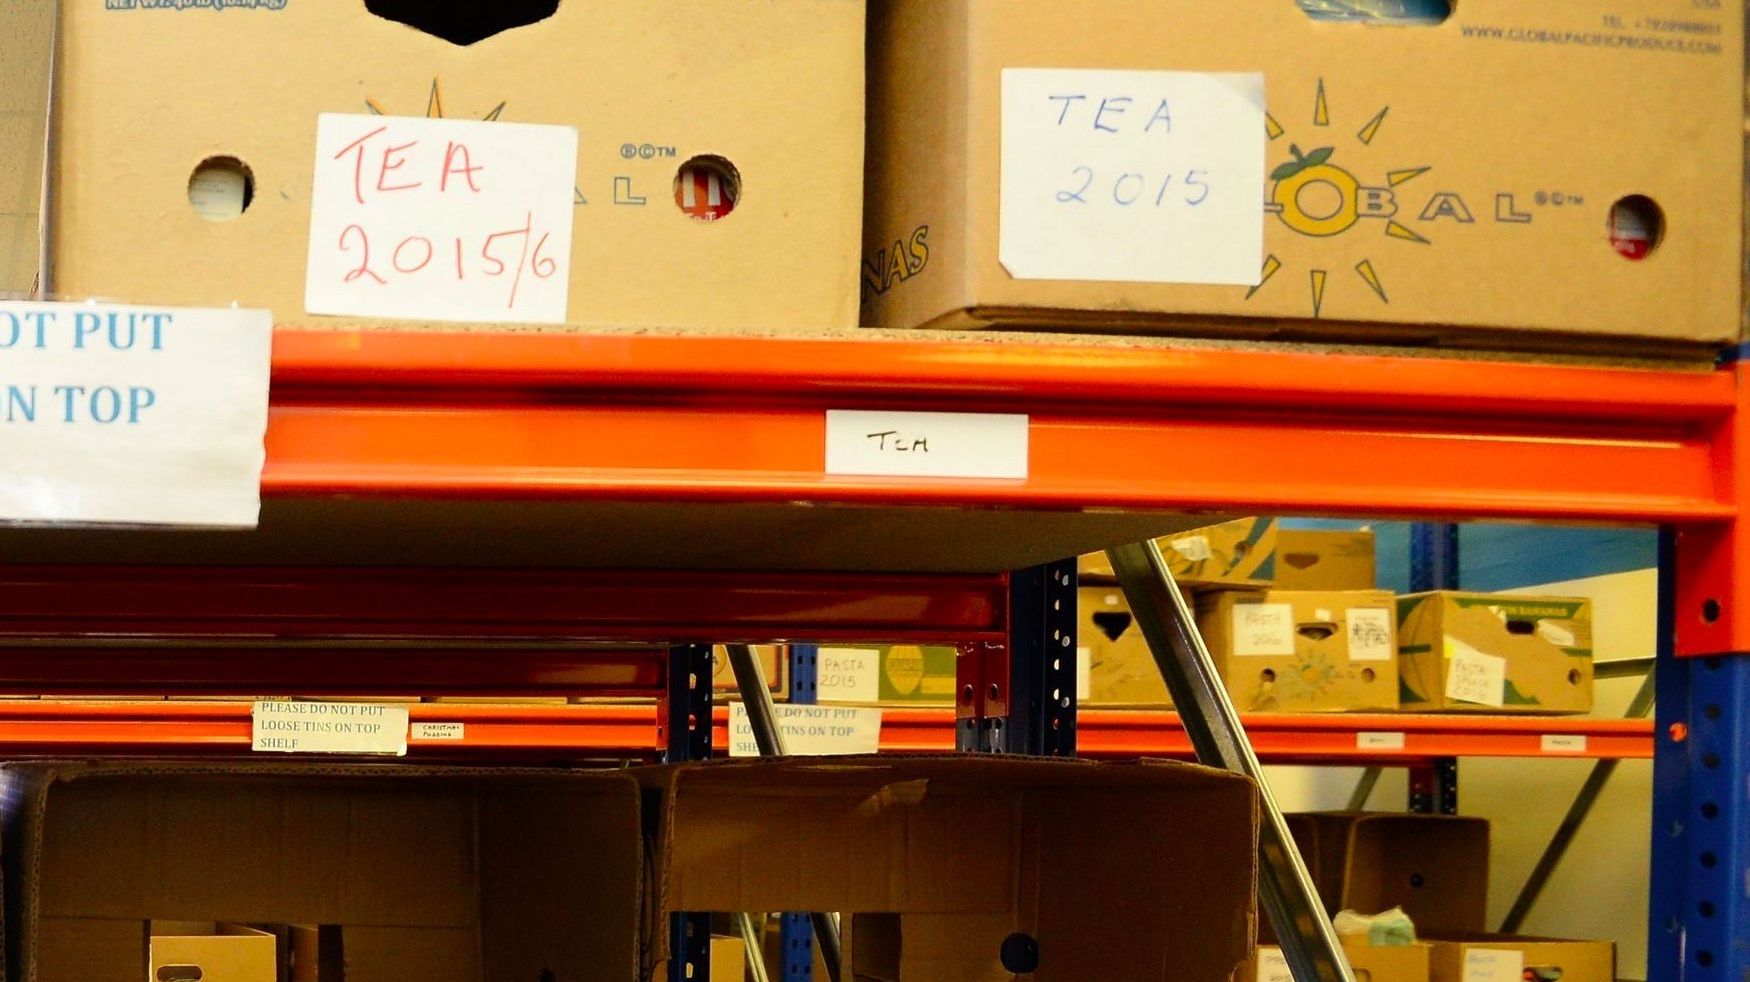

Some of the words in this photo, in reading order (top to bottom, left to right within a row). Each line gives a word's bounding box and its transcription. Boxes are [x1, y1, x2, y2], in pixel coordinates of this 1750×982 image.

[1048, 94, 1172, 134] TEA
[333, 125, 486, 204] TEA
[1055, 166, 1210, 208] 2015
[338, 210, 558, 310] 2015/6
[74, 313, 173, 350] PUT
[56, 385, 156, 423] TOP
[825, 659, 865, 671] PASTA
[820, 674, 856, 688] 2015
[262, 702, 306, 714] PLEASE
[310, 704, 327, 715] DO
[331, 705, 357, 715] NOT
[361, 706, 386, 716] PUT
[785, 708, 802, 717] DO
[804, 709, 830, 718] NOT
[833, 709, 858, 719] PUT
[261, 720, 300, 731] LOOSE
[303, 721, 332, 733] TINS
[335, 722, 352, 733] ON
[355, 723, 381, 733] TOP
[808, 727, 826, 736] ON
[830, 727, 854, 736] TOP
[260, 738, 299, 749] SHELF
